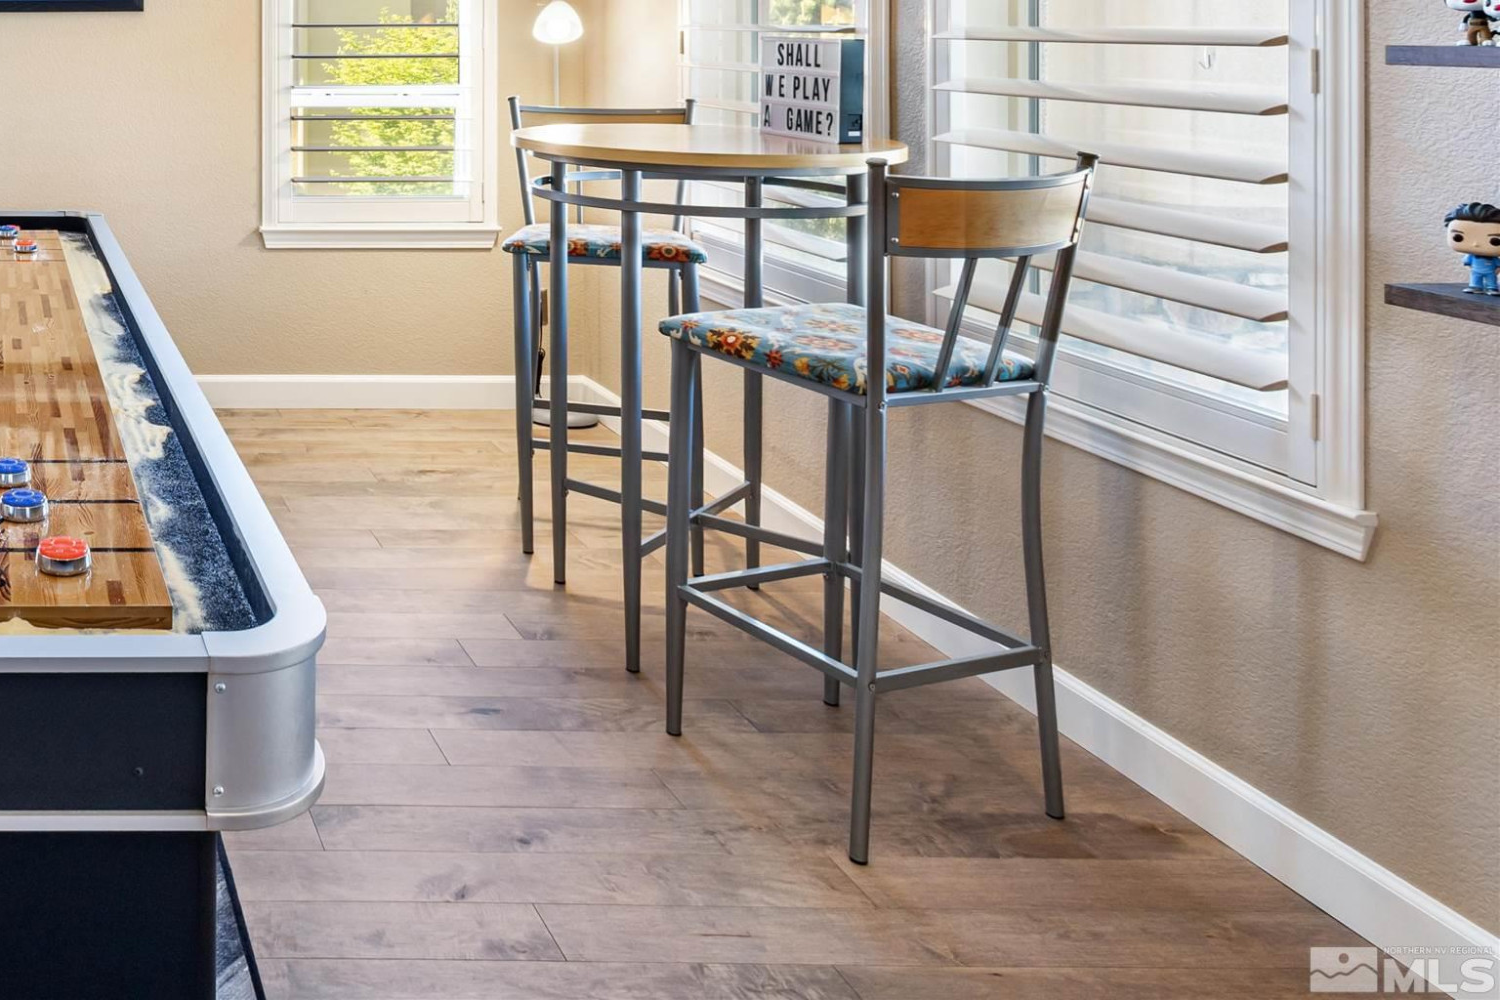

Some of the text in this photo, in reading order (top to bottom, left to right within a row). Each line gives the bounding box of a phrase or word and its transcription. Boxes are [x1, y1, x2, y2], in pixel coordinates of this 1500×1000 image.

[777, 43, 821, 68] SHALL
[765, 74, 830, 102] WE PLAY
[764, 105, 833, 136] A GAME?
